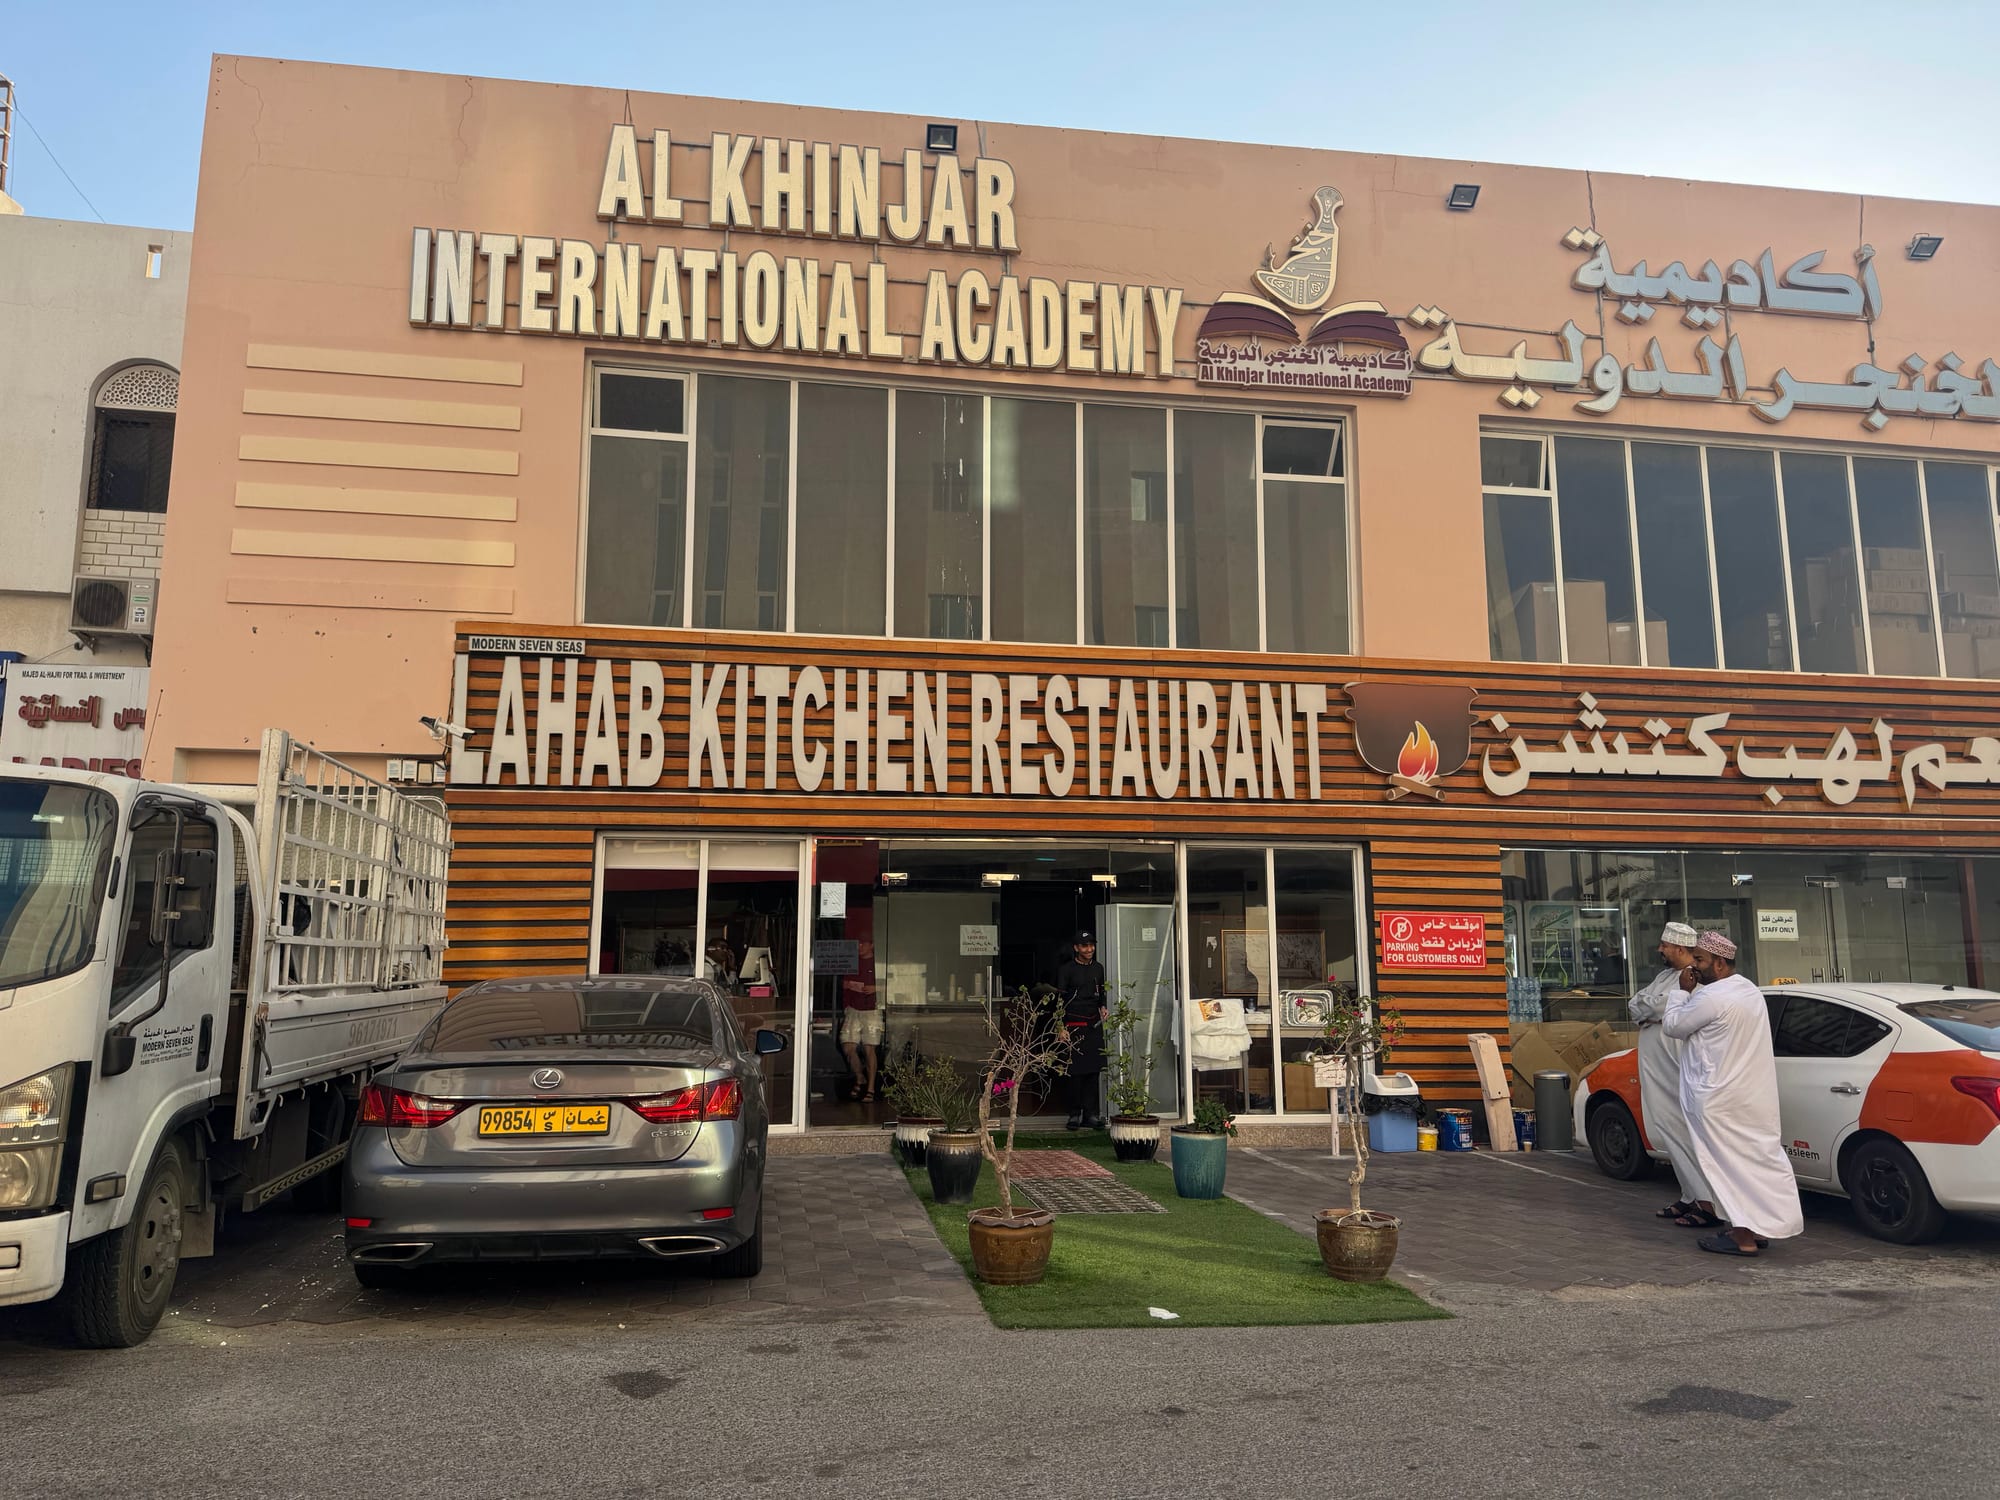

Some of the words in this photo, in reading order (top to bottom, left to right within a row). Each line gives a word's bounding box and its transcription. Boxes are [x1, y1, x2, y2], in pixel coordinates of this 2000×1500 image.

[597, 124, 684, 225] AL
[709, 131, 1019, 254] KHINJAR
[1563, 226, 1882, 331] أكاديمية
[409, 227, 903, 360] INTERNATIONAL
[919, 266, 1184, 379] ACADEMY
[1199, 339, 1262, 364] الدولية
[1265, 345, 1324, 368] الخنجر
[1327, 348, 1412, 372] أكاديمية
[1407, 303, 1747, 416] الدولية
[1201, 365, 1213, 380] Al
[1217, 366, 1264, 385] Khinjar
[1267, 370, 1351, 388] International
[1354, 374, 1412, 393] Academy
[471, 638, 516, 651] MODERN
[519, 639, 553, 652] SEVEN
[556, 641, 583, 653] SEAS
[22, 670, 39, 678] MAJED
[63, 671, 73, 679] FOR
[94, 672, 126, 680] INVESTMENT
[453, 653, 663, 787] LAHAB
[688, 662, 949, 794] KITCHEN
[971, 673, 1329, 800] RESTAURANT
[1481, 691, 1731, 797] كتشن
[1735, 717, 1894, 806] لهب
[1419, 919, 1446, 932] خاص
[1450, 919, 1480, 932] موقف
[1387, 943, 1419, 952] PARKING
[1420, 937, 1445, 948] فقط
[1387, 953, 1404, 962] FOR
[1407, 954, 1457, 963] CUSTOMERS
[1460, 955, 1481, 964] ONLY
[483, 1111, 533, 1131] 99854
[544, 1122, 552, 1131] S
[1782, 1144, 1820, 1160] Tasleem
